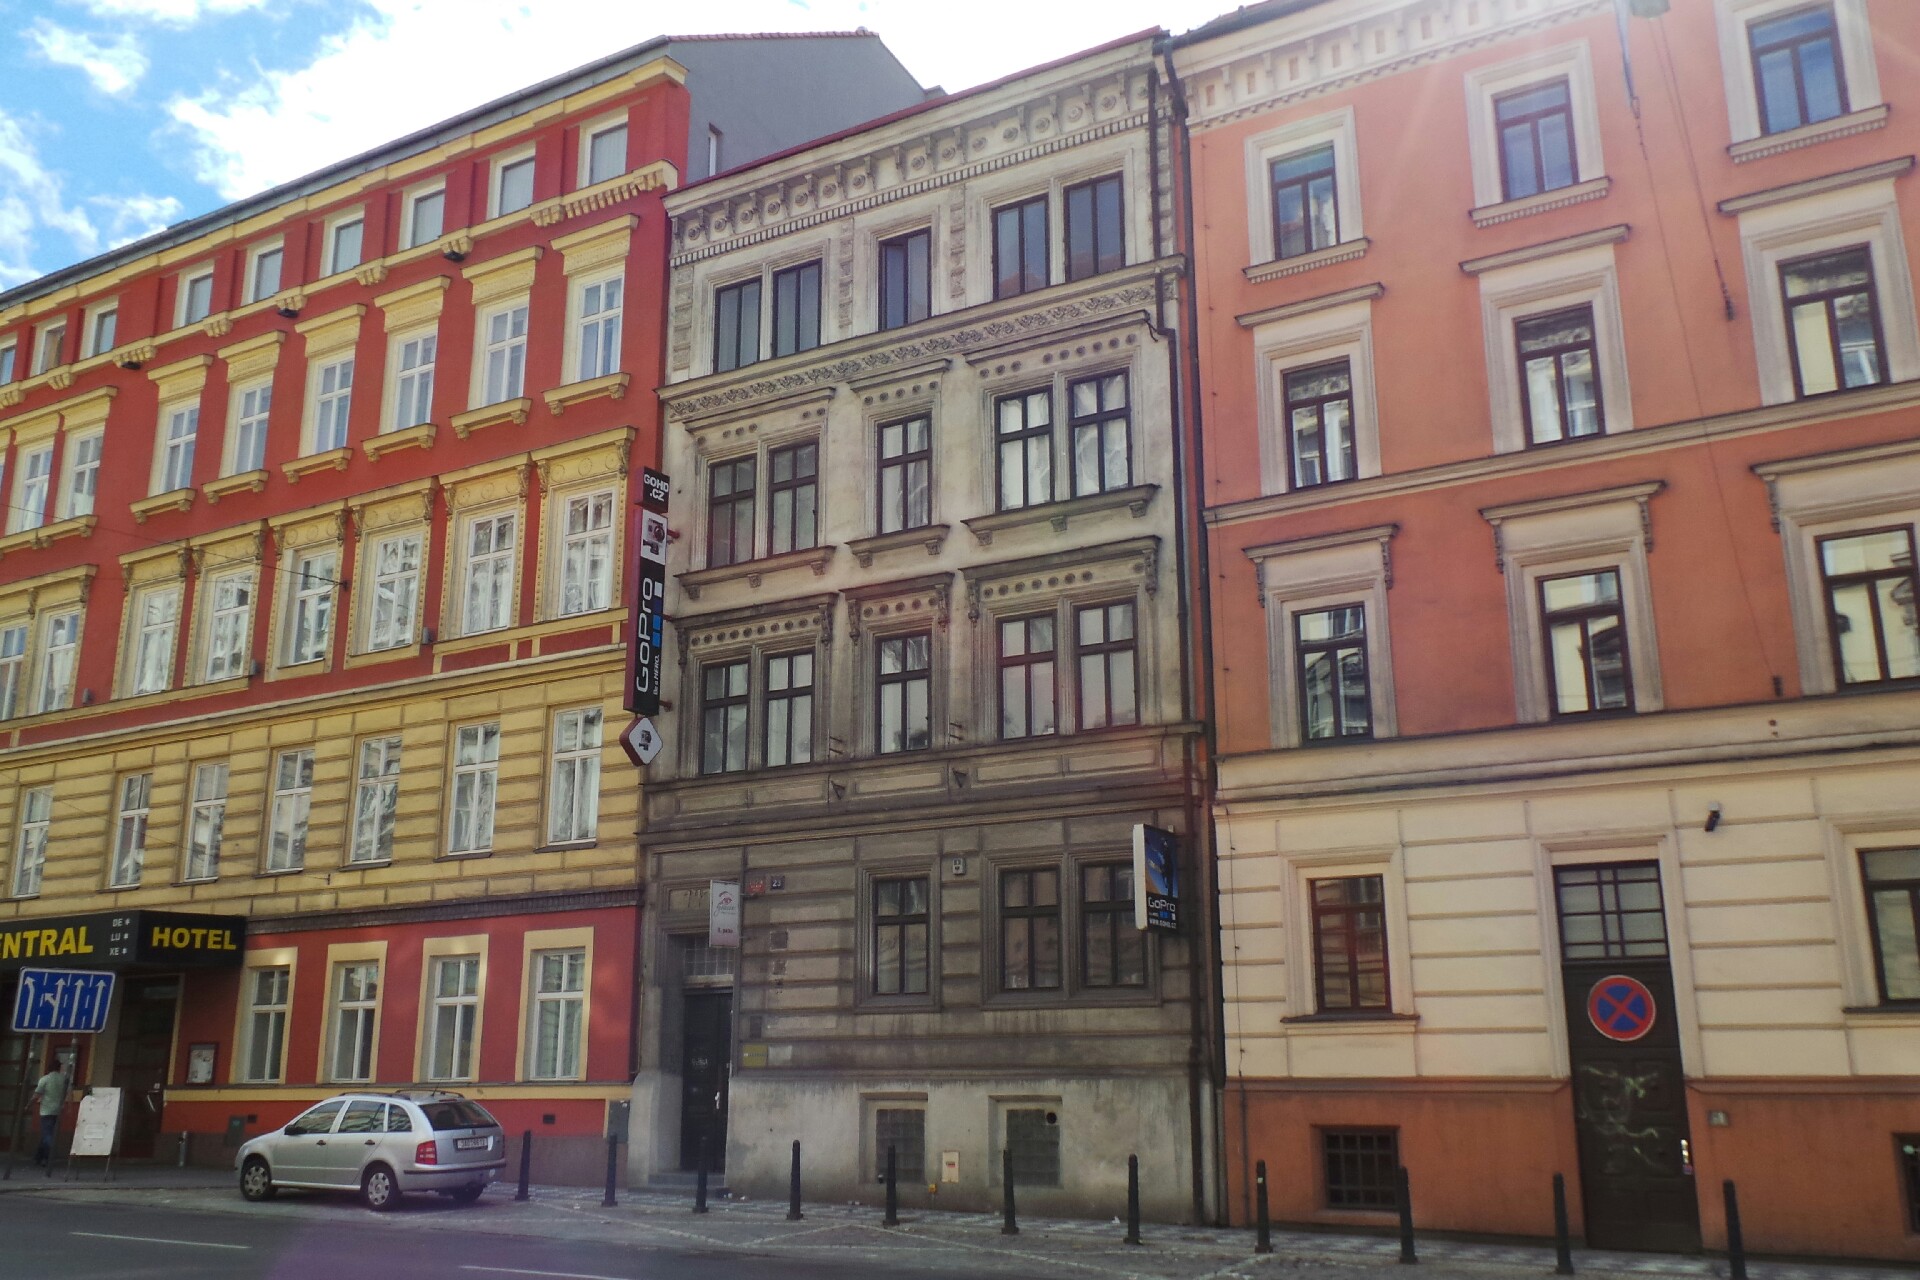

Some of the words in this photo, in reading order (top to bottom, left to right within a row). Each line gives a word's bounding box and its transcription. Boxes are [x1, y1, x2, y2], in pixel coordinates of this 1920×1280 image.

[644, 474, 669, 493] GOHD
[650, 488, 665, 502] .CZ
[636, 577, 653, 693] GoPro
[1148, 896, 1176, 912] GoPro
[112, 918, 123, 927] DE
[0, 926, 94, 959] NTRAL
[110, 933, 121, 941] LU
[152, 926, 237, 950] HOTEL
